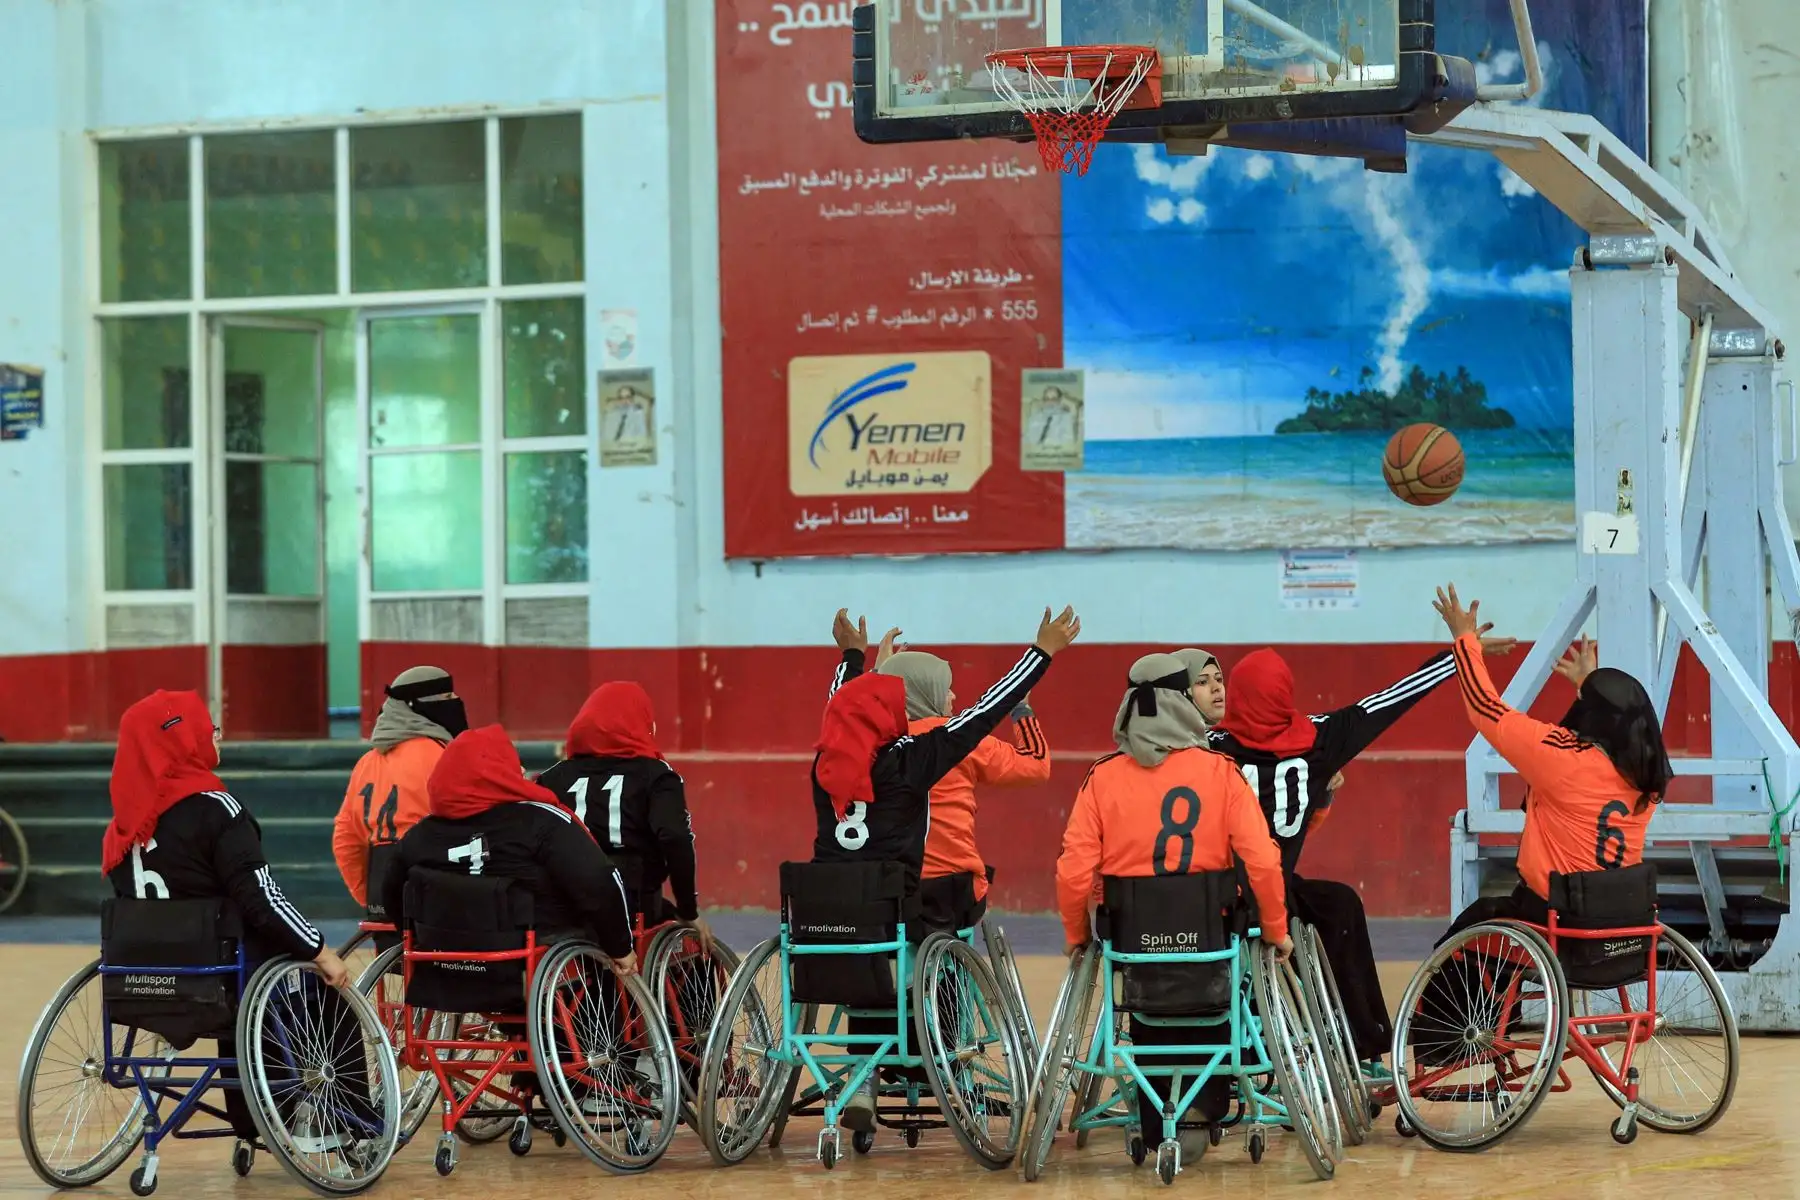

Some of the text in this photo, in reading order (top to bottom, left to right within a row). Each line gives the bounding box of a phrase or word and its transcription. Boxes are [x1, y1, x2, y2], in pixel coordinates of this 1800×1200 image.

[769, 0, 854, 46] سمح
[1001, 299, 1038, 321] 555
[845, 412, 966, 451] Yemen
[866, 448, 961, 467] Mobile
[845, 469, 949, 490] يمن موبايل
[932, 503, 970, 524] معنا
[1607, 528, 1619, 549] 7
[566, 774, 625, 848] 11
[834, 800, 870, 851] 8
[1152, 786, 1201, 876] 8
[1595, 800, 1630, 870] 6
[808, 924, 856, 933] motivation
[1140, 932, 1198, 947] Spin Off
[1146, 945, 1198, 953] motivation
[441, 962, 487, 972] motivation
[125, 974, 176, 985] Multisport
[132, 986, 176, 995] motivation
